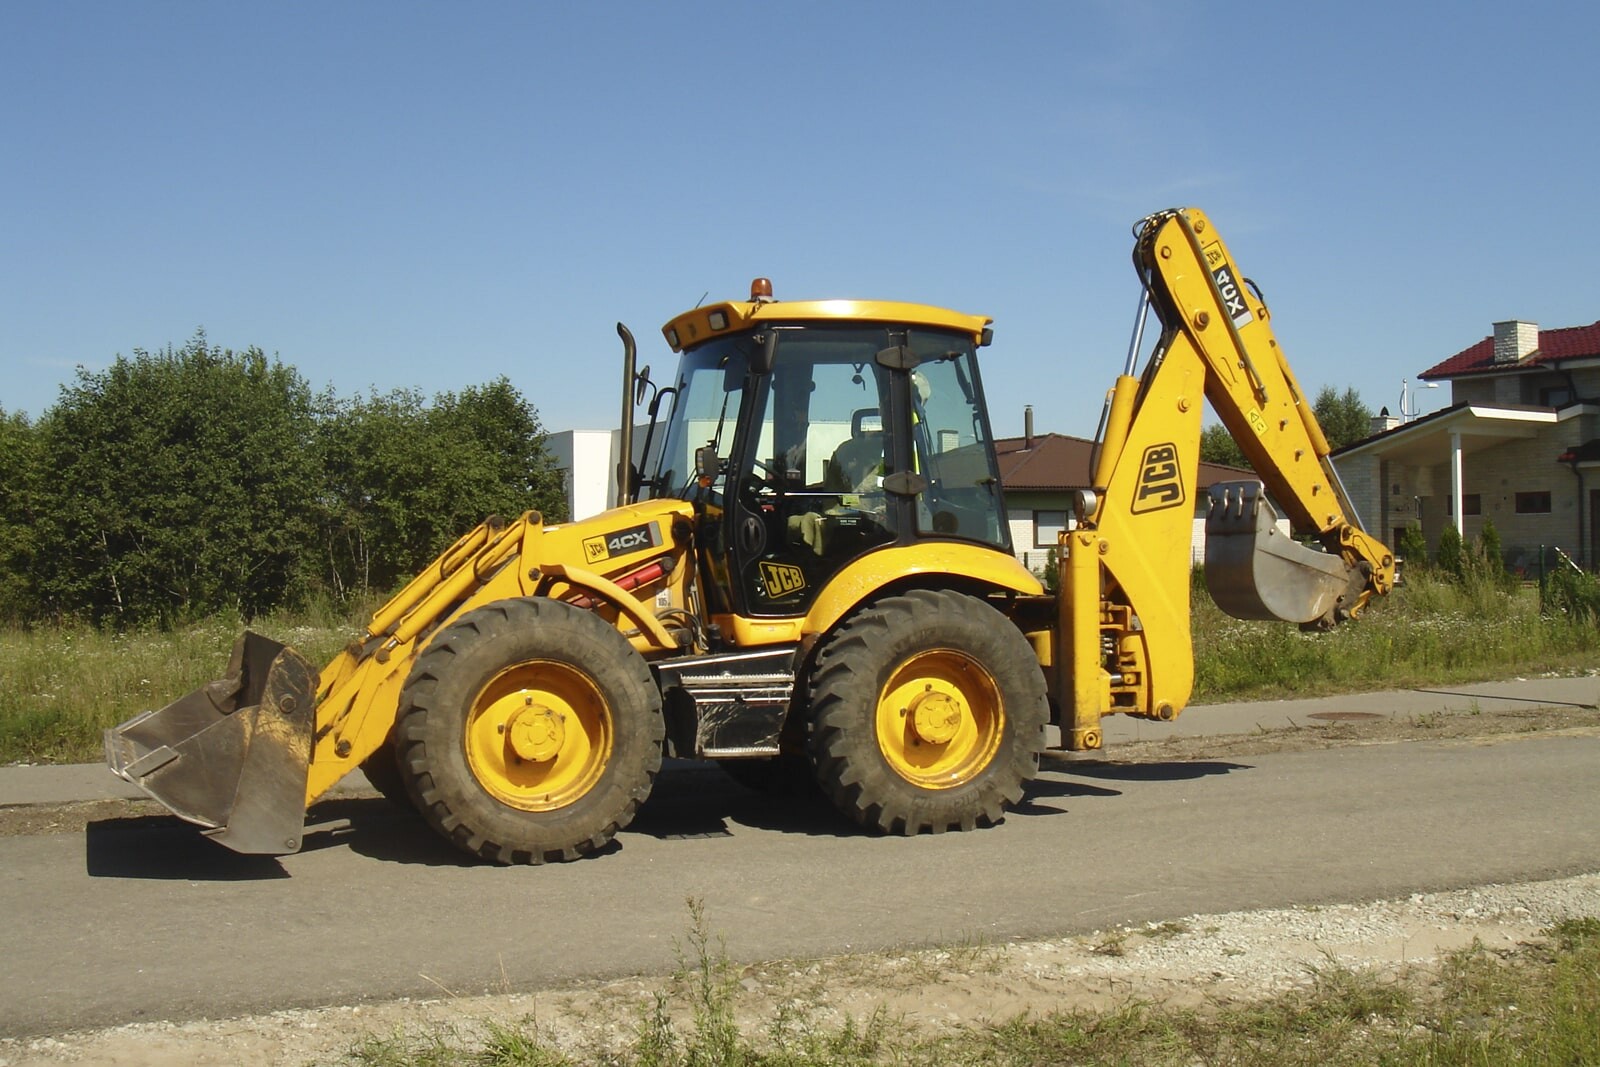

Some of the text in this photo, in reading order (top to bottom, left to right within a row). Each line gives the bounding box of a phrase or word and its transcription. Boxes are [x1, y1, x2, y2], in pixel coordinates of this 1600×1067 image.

[1217, 270, 1244, 315] 4CX
[1138, 447, 1180, 503] JCB
[608, 531, 649, 550] 4CX
[767, 565, 803, 595] JCB
